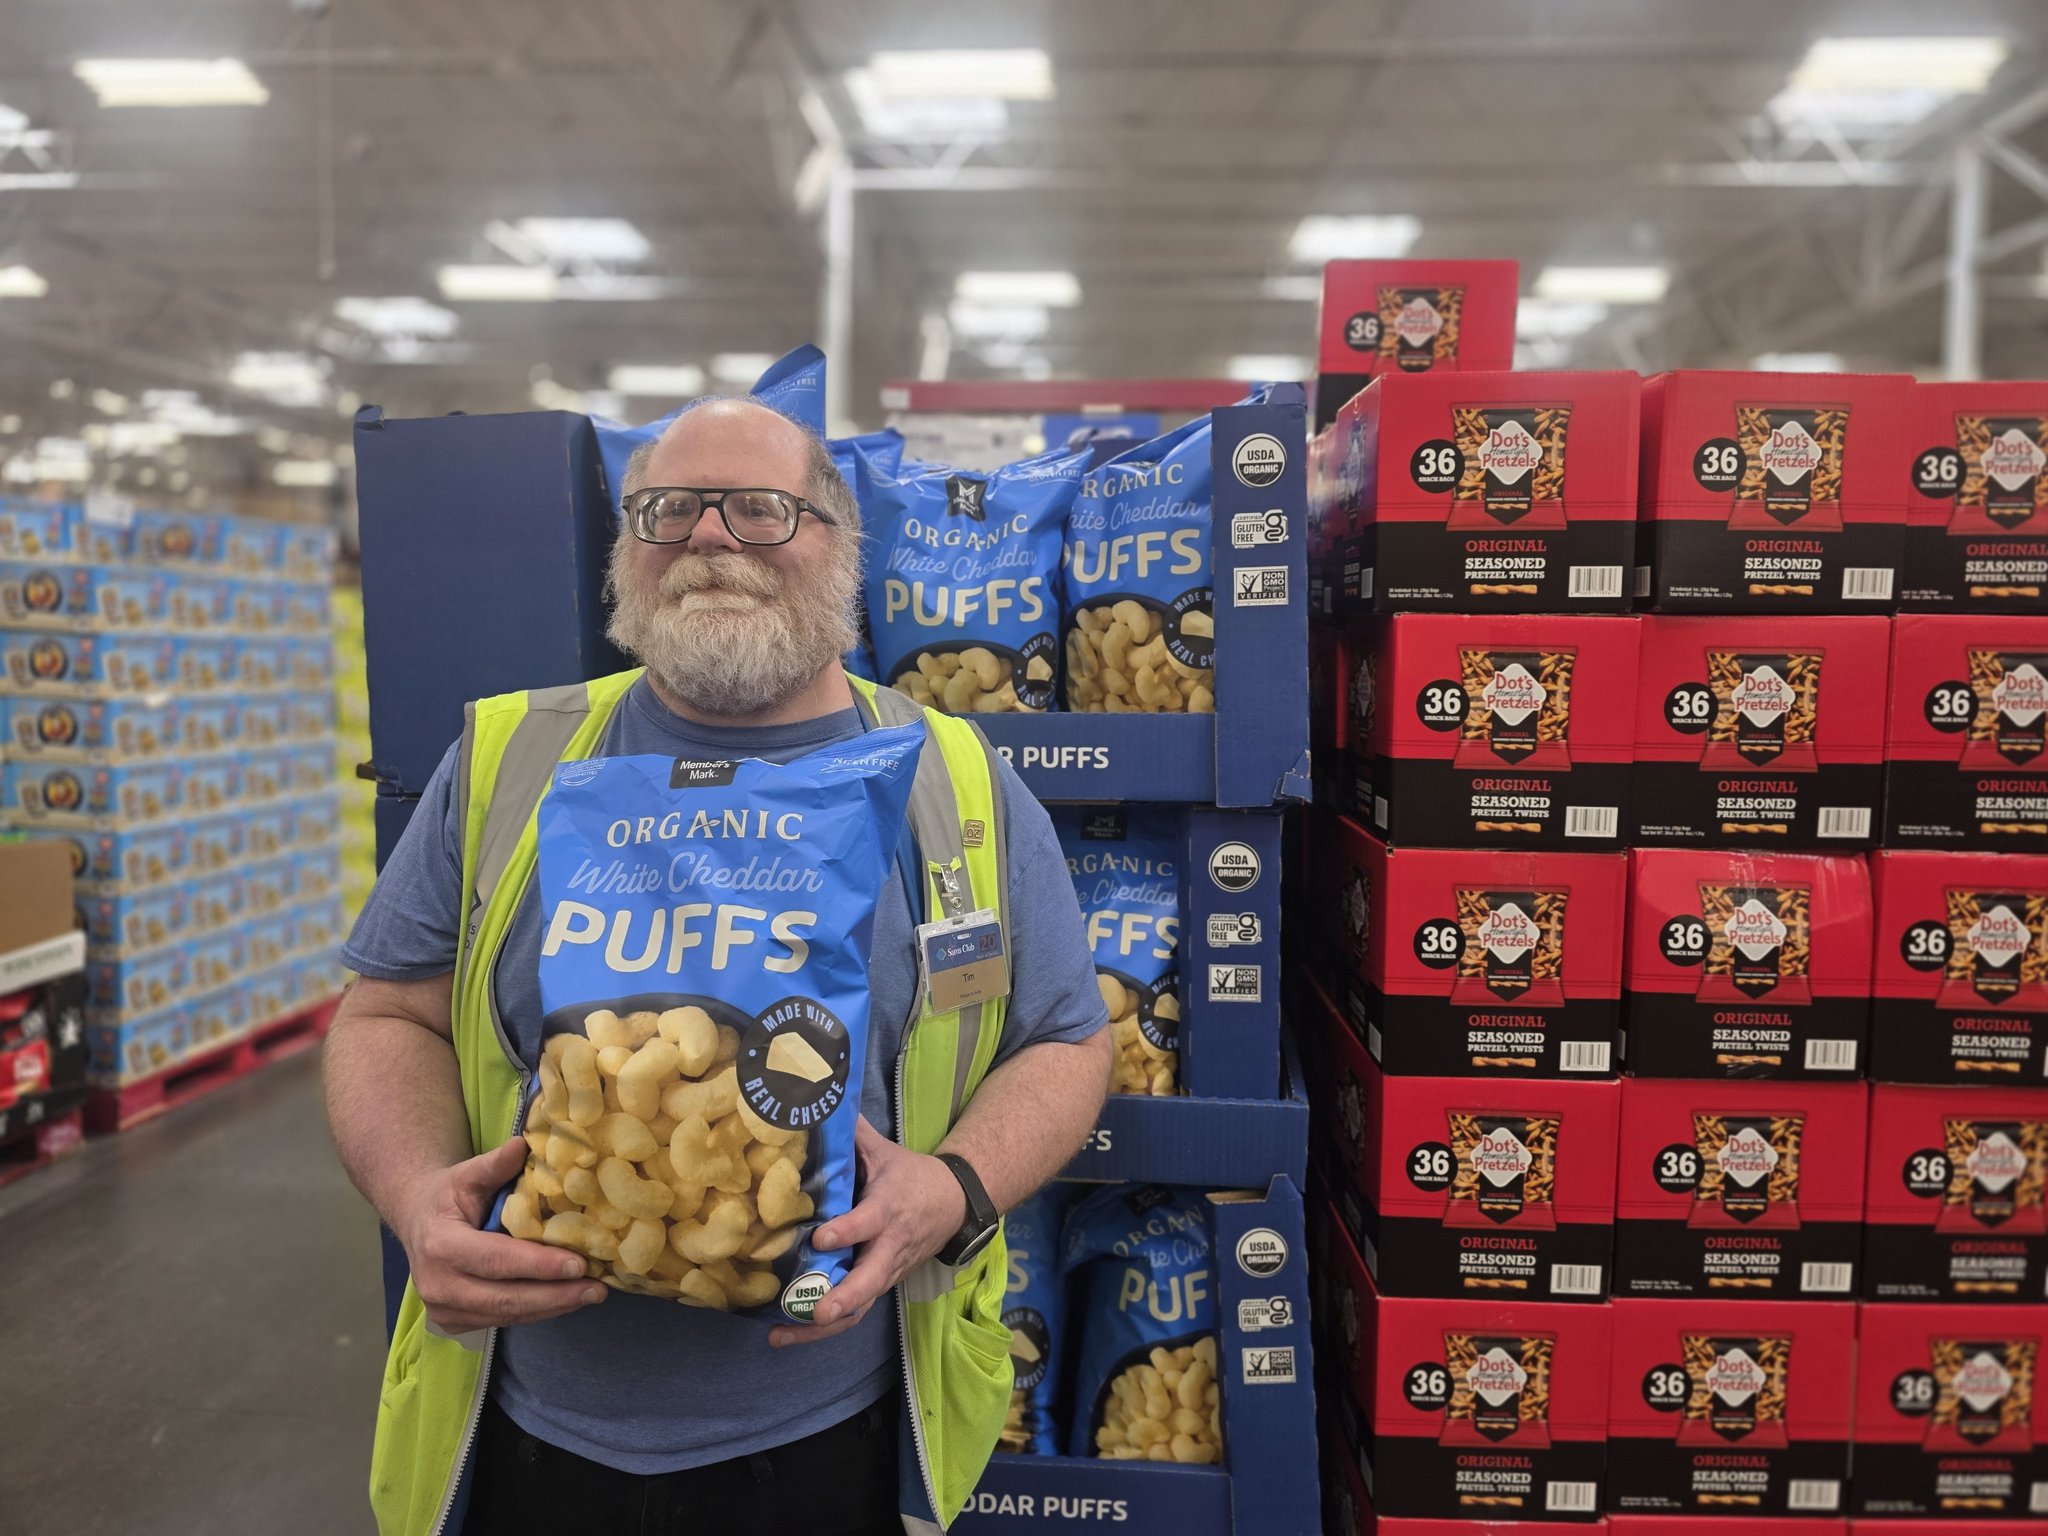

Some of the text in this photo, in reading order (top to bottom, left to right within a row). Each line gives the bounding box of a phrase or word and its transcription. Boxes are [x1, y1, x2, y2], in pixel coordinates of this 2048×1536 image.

[1490, 430, 1530, 450] Dot's
[1772, 430, 1810, 450] Dot's
[1247, 449, 1275, 461] USDA
[1418, 448, 1456, 475] 36
[1481, 454, 1538, 468] Pretzels
[1701, 446, 1738, 473] 36
[1762, 454, 1816, 468] Pretzels
[1243, 464, 1279, 474] ORGANIC
[1920, 455, 1958, 481] 36
[1083, 464, 1184, 498] RGANIC
[1111, 496, 1200, 531] Cheddar
[904, 513, 1028, 552] ORGANIC
[1236, 523, 1265, 533] GLUTEN
[1236, 534, 1254, 542] FREE
[1465, 540, 1547, 552] ORIGINAL
[1745, 540, 1824, 553] ORIGINAL
[1966, 544, 2048, 556] ORIGINAL
[886, 542, 1038, 582] White Cheddar
[1465, 557, 1546, 569] SEASONED
[1744, 557, 1822, 570] SEASONED
[1966, 561, 2048, 572] SEASONED
[1464, 571, 1546, 580] PRETZEL TWISTS
[884, 576, 1043, 628] PUFFS
[1174, 592, 1200, 612] MADE
[1169, 639, 1194, 664] REAL
[1494, 674, 1533, 691] Dot's
[1744, 674, 1782, 693] Dot's
[2006, 674, 2044, 692] Dot's
[1425, 688, 1461, 714] 36
[1486, 695, 1540, 710] Pretzels
[1672, 690, 1710, 717] 36
[1735, 697, 1790, 712] Pretzels
[1933, 689, 1970, 716] 36
[872, 758, 900, 771] FREE
[1022, 746, 1110, 768] PUFFS
[690, 769, 714, 780] Mark
[1472, 778, 1552, 792] ORIGINAL
[1718, 780, 1798, 794] ORIGINAL
[1471, 796, 1550, 808] SEASONED
[1717, 797, 1797, 810] SEASONED
[1471, 808, 1549, 818] PRETZEL TWISTS
[606, 810, 804, 848] ORGANIC
[1066, 852, 1174, 876] RGANIC
[1222, 855, 1248, 865] USDA
[567, 850, 824, 895] White Cheddar
[1218, 868, 1252, 877] ORGANIC
[1092, 879, 1178, 906] Chedda
[1491, 912, 1528, 929] Dot's
[1736, 908, 1772, 927] Dot's
[1981, 913, 2018, 932] Dot's
[1082, 910, 1180, 960] FFS
[1211, 923, 1238, 932] GLUTEN
[541, 900, 818, 974] PUFFS
[980, 934, 996, 951] 20
[1212, 932, 1228, 940] FREE
[1421, 926, 1458, 952] 36
[1482, 934, 1535, 949] Pretzels
[1667, 924, 1704, 950] 36
[1729, 931, 1781, 946] Pretzels
[1908, 929, 1945, 955] 36
[962, 942, 975, 952] Club
[1971, 937, 2024, 952] Pretzels
[962, 973, 976, 983] Tim
[762, 1002, 835, 1032] MADE WITH
[1468, 1015, 1546, 1028] ORIGINAL
[1714, 1012, 1792, 1026] ORIGINAL
[1954, 1018, 2032, 1032] ORIGINAL
[1142, 1020, 1164, 1046] REAL
[1468, 1031, 1545, 1044] SEASONED
[1713, 1029, 1790, 1042] SEASONED
[1467, 1044, 1544, 1054] PRETZEL TWISTS
[1952, 1036, 2031, 1048] SEASONED
[745, 1076, 844, 1126] REAL CHEESE
[1483, 1137, 1519, 1154] Dot's
[1730, 1138, 1765, 1155] Dot's
[1414, 1150, 1449, 1175] 36
[1475, 1158, 1526, 1173] Pretzels
[1661, 1151, 1697, 1177] 36
[1721, 1158, 1772, 1173] Pretzels
[1112, 1206, 1205, 1258] ORGAN
[1250, 1242, 1276, 1252] USDA
[1460, 1237, 1537, 1250] ORIGINAL
[1705, 1237, 1782, 1250] ORIGINAL
[1247, 1255, 1280, 1264] ORGANIC
[1460, 1254, 1536, 1266] SEASONED
[1704, 1254, 1780, 1266] SEASONED
[796, 1285, 824, 1298] USDA
[1118, 1268, 1208, 1322] PUF
[792, 1302, 816, 1312] ORGA
[1243, 1308, 1270, 1317] GLUTEN
[1243, 1317, 1260, 1325] FREE
[1478, 1357, 1514, 1374] Dot's
[1718, 1356, 1753, 1374] Dot's
[1411, 1370, 1446, 1394] 36
[1471, 1377, 1521, 1392] Pretzels
[1650, 1372, 1685, 1397] 36
[1710, 1377, 1760, 1393] Pretzels
[1456, 1456, 1532, 1468] ORIGINAL
[1693, 1455, 1770, 1468] ORIGINAL
[1456, 1471, 1531, 1483] SEASONED
[1693, 1471, 1768, 1484] SEASONED
[1044, 1496, 1128, 1521] PUFFS
